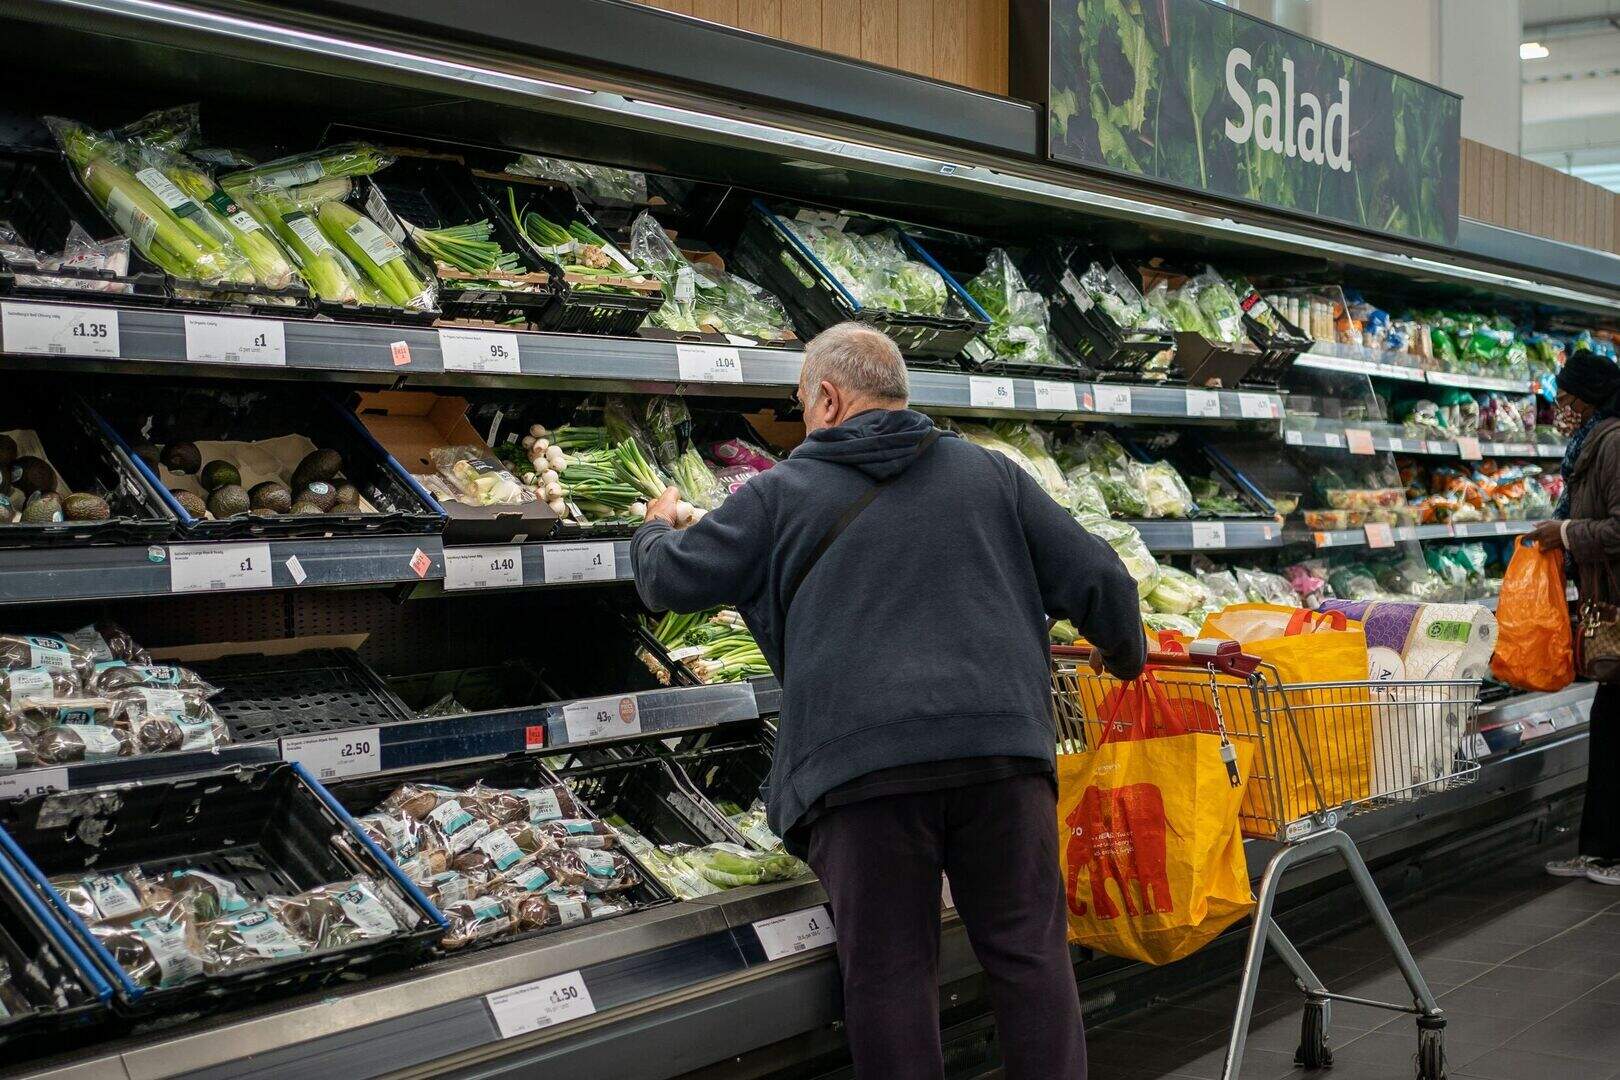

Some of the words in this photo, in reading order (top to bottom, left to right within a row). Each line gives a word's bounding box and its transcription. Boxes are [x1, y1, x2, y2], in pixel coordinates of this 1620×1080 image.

[1225, 47, 1352, 173] Salad
[73, 322, 108, 338] £1.35
[254, 333, 267, 347] £1
[490, 345, 509, 359] 95p
[240, 557, 253, 571] £1
[490, 558, 514, 571] £1.40
[592, 553, 603, 566] £1
[341, 741, 370, 757] £2.50
[808, 917, 820, 931] £1
